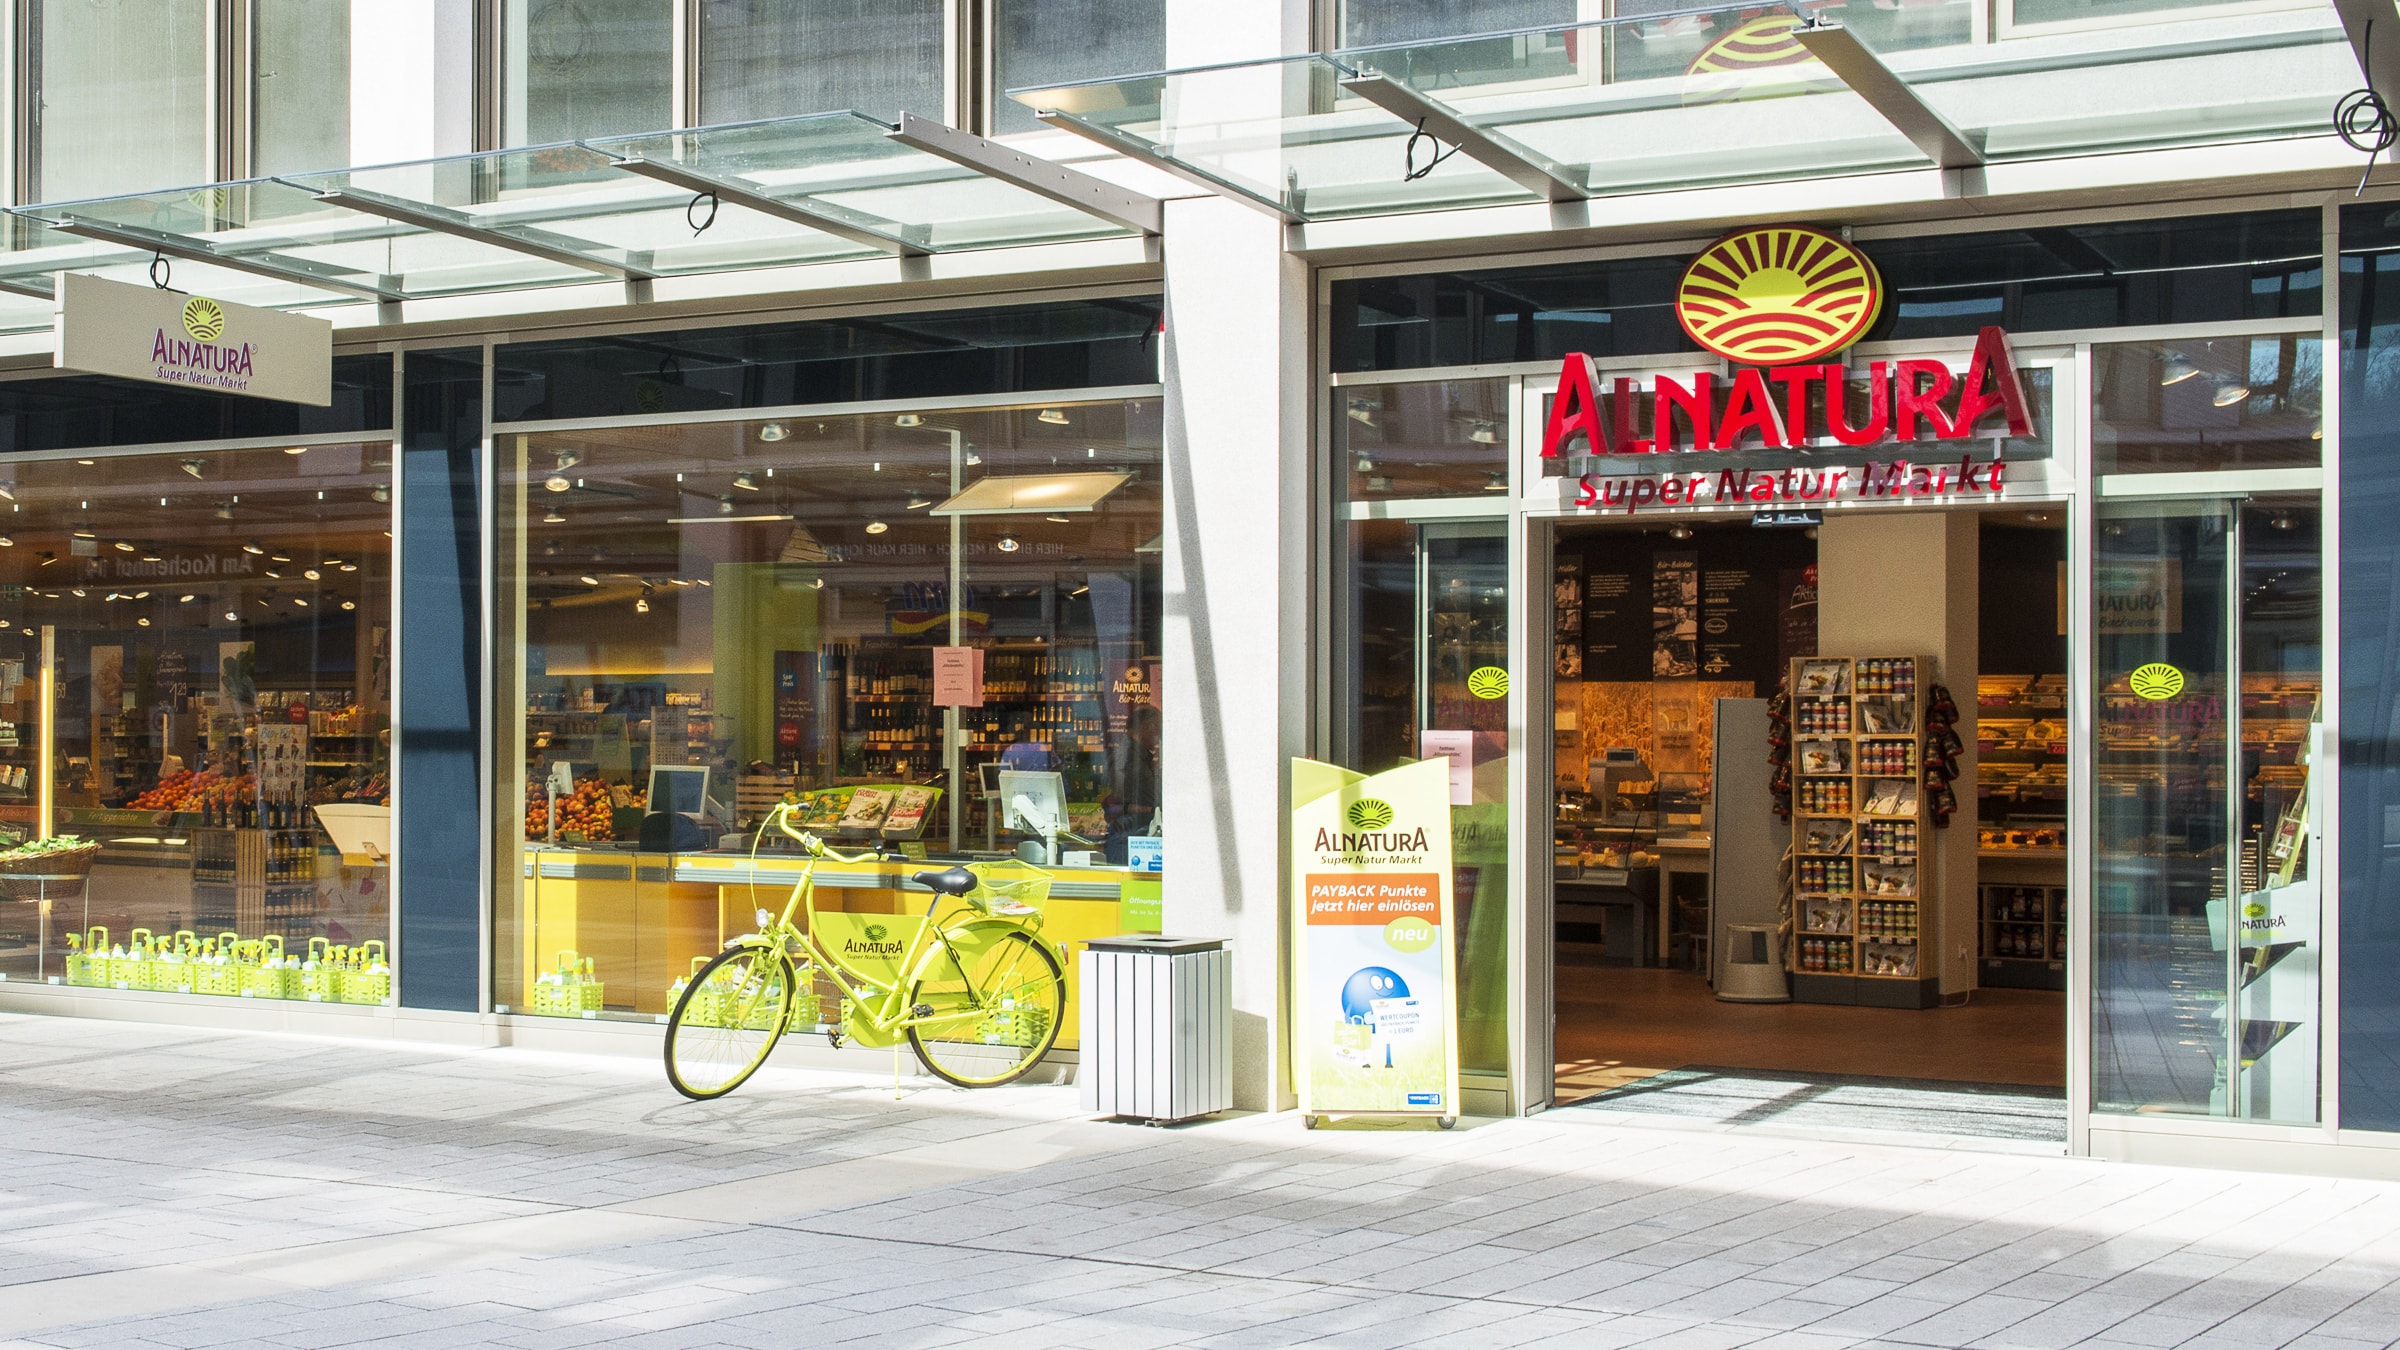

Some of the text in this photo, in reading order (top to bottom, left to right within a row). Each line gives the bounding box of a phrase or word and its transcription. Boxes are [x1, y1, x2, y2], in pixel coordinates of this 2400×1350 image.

[151, 328, 253, 377] ALNATURA
[156, 366, 248, 391] Super Natur Markt
[1540, 326, 2038, 458] ALNATURA
[1574, 454, 2007, 514] Super Natur Markt
[1112, 679, 1151, 693] ALNATUR
[1314, 827, 1429, 852] ALNATURA
[1321, 855, 1422, 866] Super Natur Markt
[1311, 884, 1427, 897] PAYBACK Punkte
[1310, 899, 1435, 915] jetzt hier einlösen
[2241, 915, 2286, 930] NATURA
[1392, 927, 1428, 941] neu
[844, 938, 903, 953] ALNATURA
